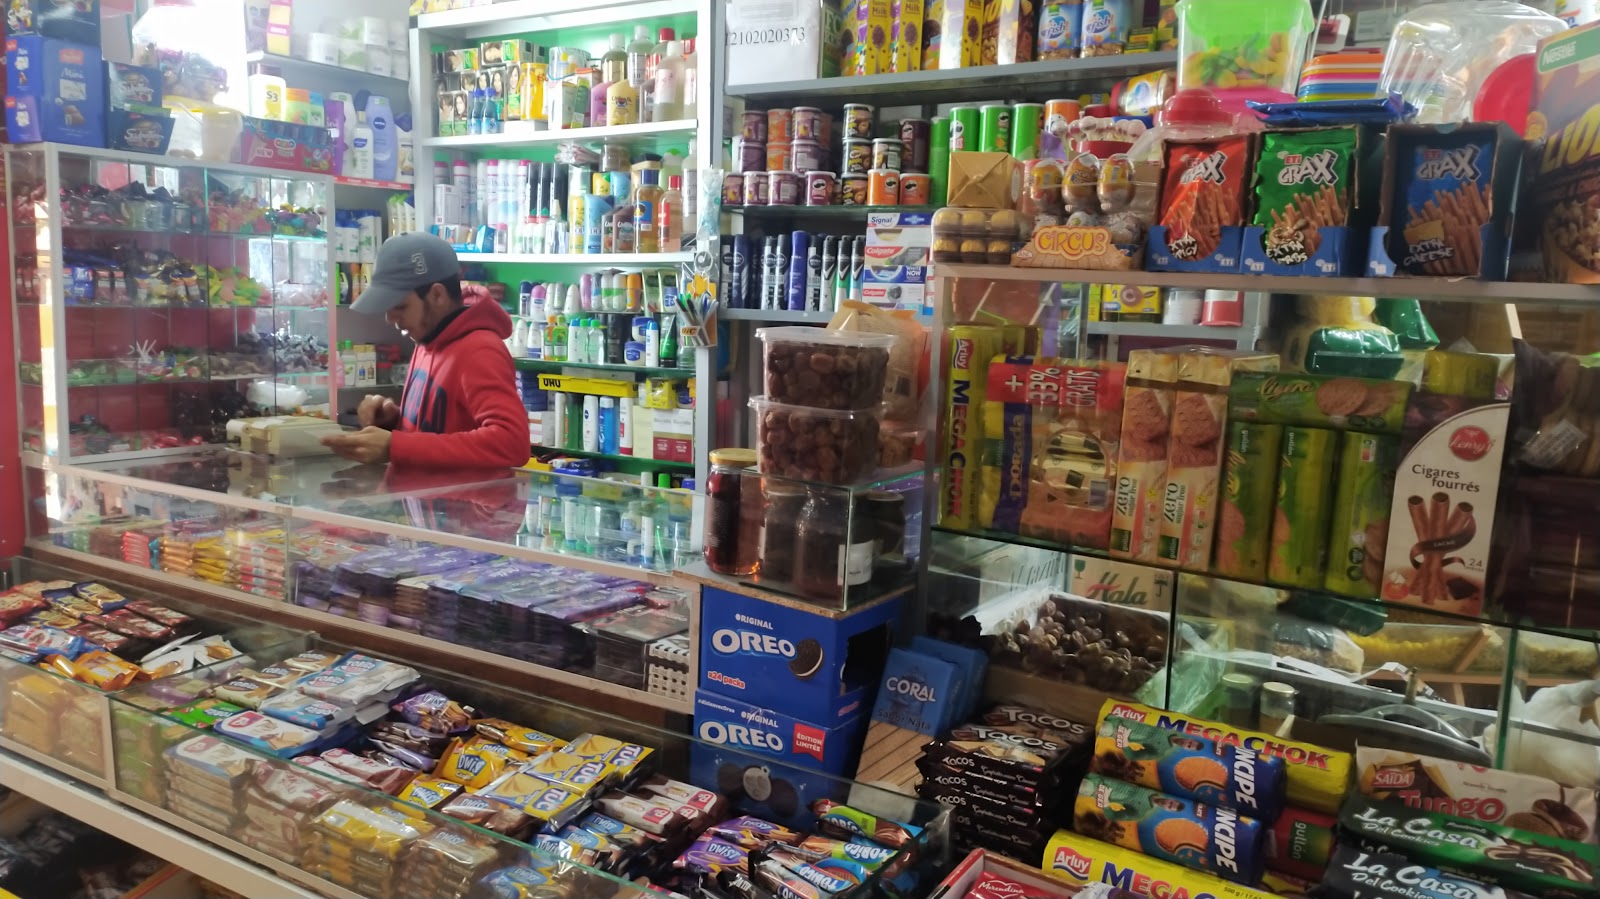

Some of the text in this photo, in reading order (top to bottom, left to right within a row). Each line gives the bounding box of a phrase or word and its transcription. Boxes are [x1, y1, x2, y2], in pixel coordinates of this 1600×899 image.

[1278, 149, 1339, 185] CRAX
[1416, 145, 1481, 180] CRAX
[870, 216, 893, 226] Signal
[866, 247, 895, 256] Colgate
[1412, 464, 1460, 480] Cigares
[1431, 477, 1480, 493] fourrés
[1469, 558, 1483, 567] 24
[735, 613, 774, 630] ORIGINAL
[712, 629, 796, 658] OREO
[723, 675, 745, 690] packs
[886, 676, 937, 702] CORAL
[741, 711, 779, 728] ORIGINAL
[909, 718, 931, 731] Nata
[700, 721, 784, 751] OREO
[796, 732, 823, 745] ÉDITION
[795, 740, 821, 752] LIMITÉE
[614, 745, 642, 767] TUC
[573, 762, 604, 784] TUC
[536, 788, 567, 811] TUC
[1354, 807, 1397, 828] La
[1404, 818, 1481, 849] Casa
[1362, 823, 1388, 834] Del
[1391, 827, 1441, 846] Cookies
[1055, 850, 1090, 874] Arluy
[1343, 852, 1477, 899] La Casa
[1352, 872, 1380, 886] Del
[978, 881, 1025, 894] Merendina
